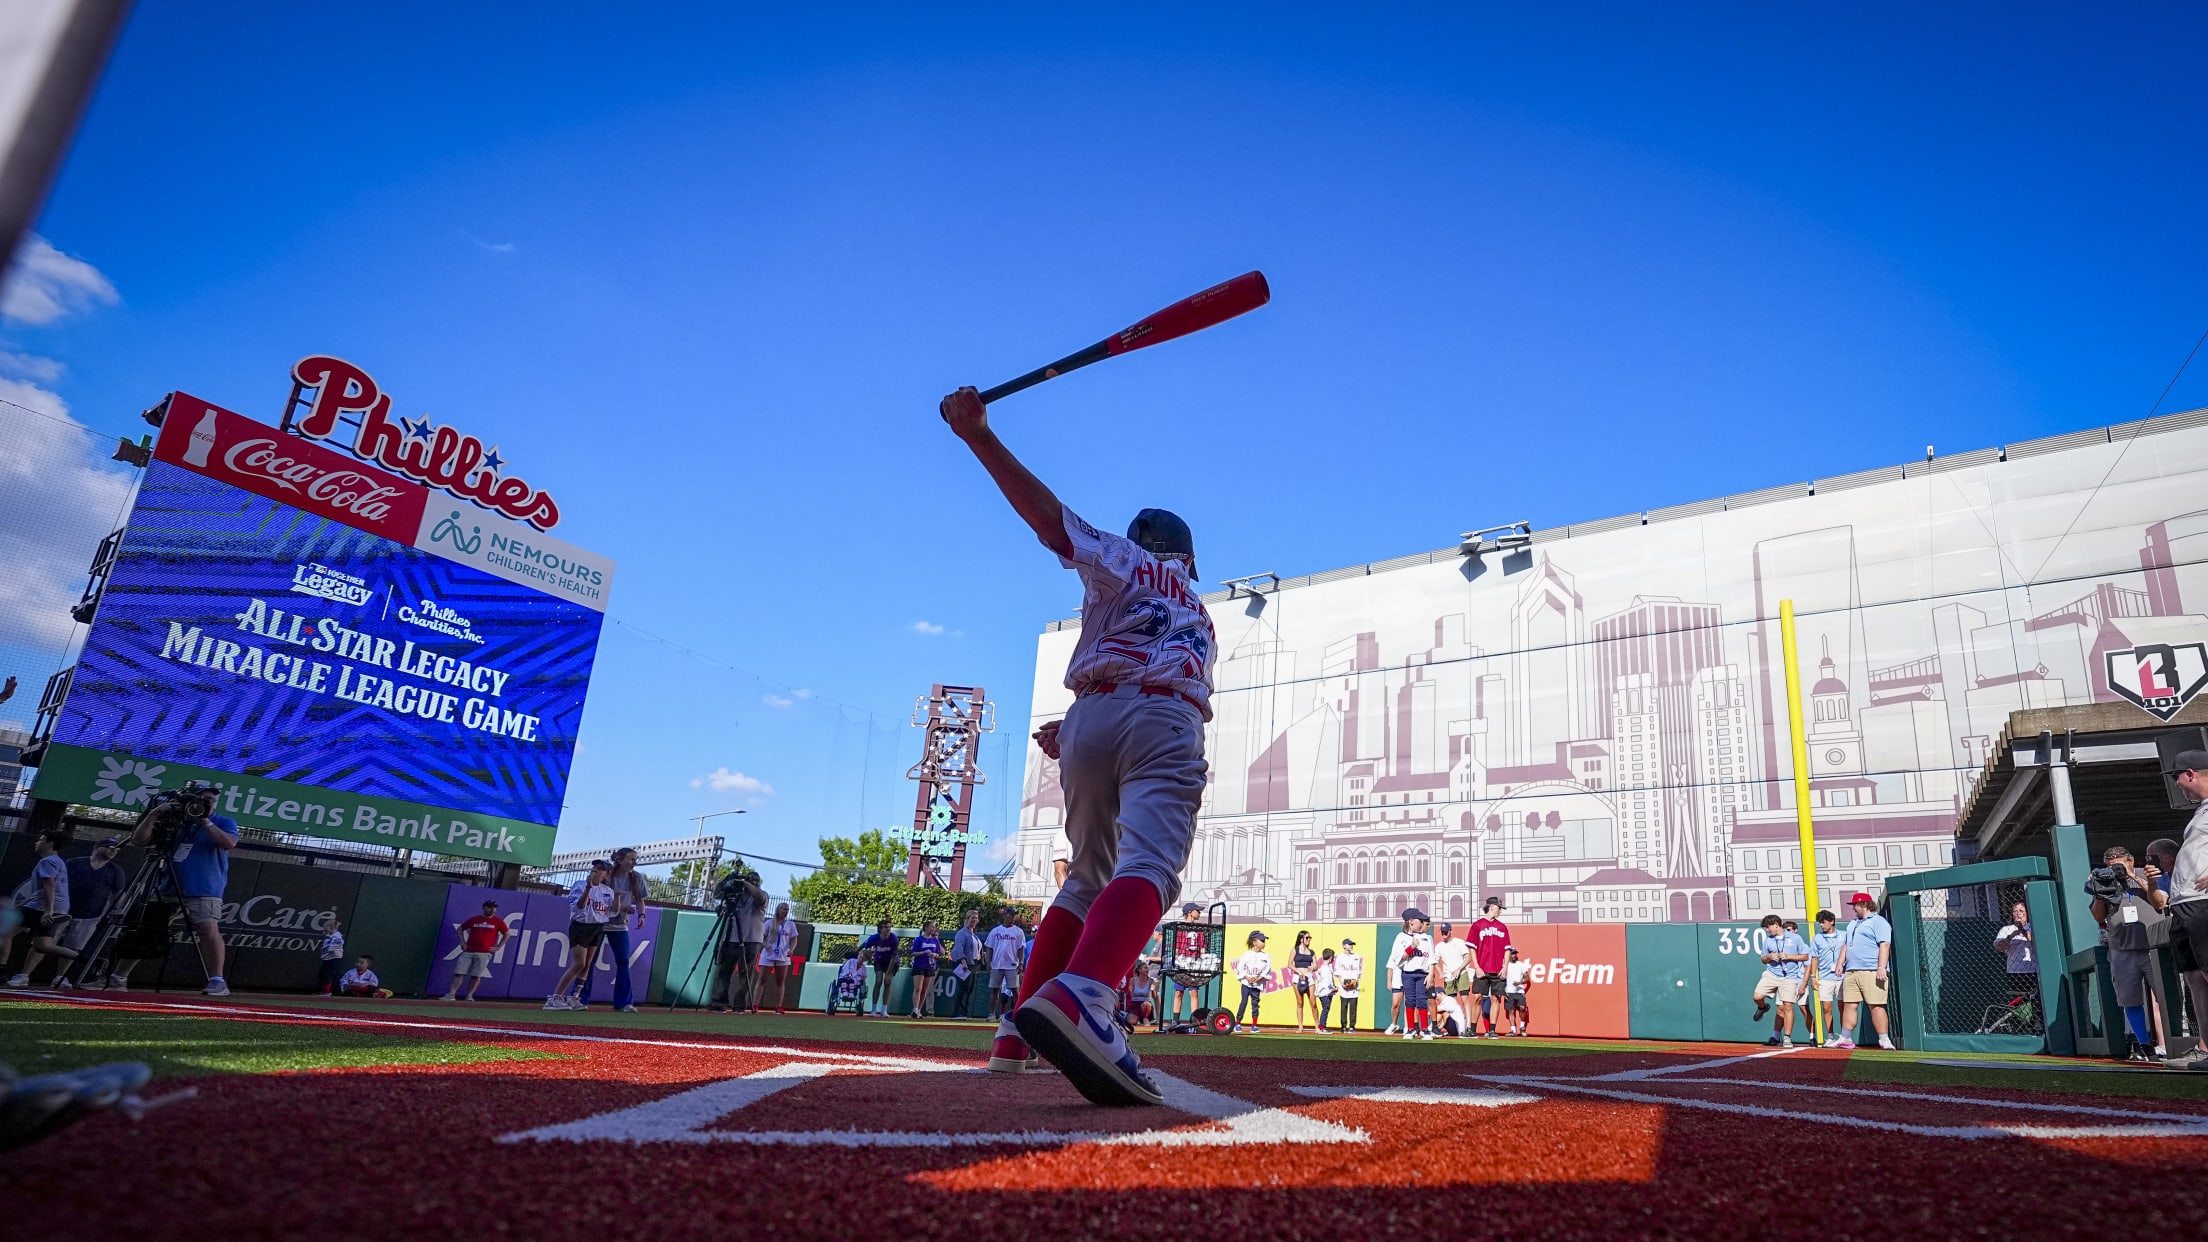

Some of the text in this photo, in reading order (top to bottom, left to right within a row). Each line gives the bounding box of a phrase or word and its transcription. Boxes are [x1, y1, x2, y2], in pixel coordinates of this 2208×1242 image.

[290, 354, 560, 530] Phillies
[224, 438, 406, 520] Coca-Cola
[487, 551, 600, 600] CHILDREN'S HEALTH
[490, 532, 603, 586] NEMOURS
[291, 564, 374, 607] Legacy
[421, 599, 471, 628] Phillies
[158, 620, 540, 742] MIRACLE LEAGUE GAME
[400, 640, 510, 697] LEGACY
[2142, 696, 2181, 709] 101
[353, 804, 440, 842] Bank
[888, 825, 988, 845] Citizens Bank
[920, 842, 954, 857] Park
[217, 894, 337, 931] aCare
[1718, 927, 1767, 955] 330
[932, 975, 957, 998] 40
